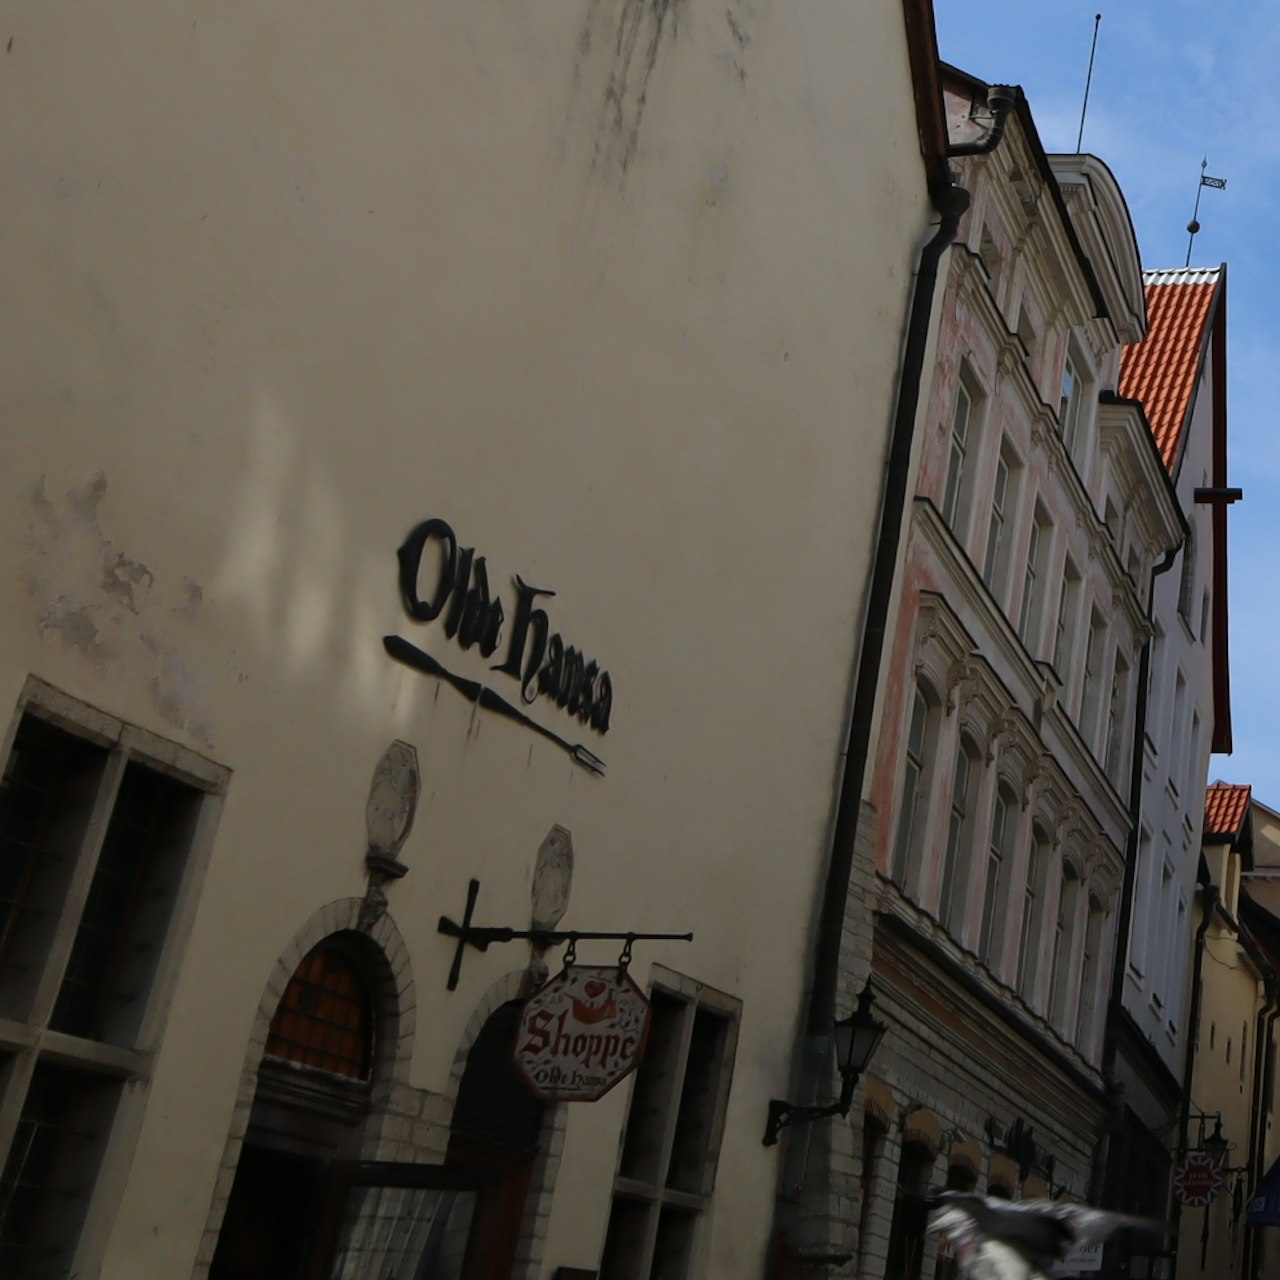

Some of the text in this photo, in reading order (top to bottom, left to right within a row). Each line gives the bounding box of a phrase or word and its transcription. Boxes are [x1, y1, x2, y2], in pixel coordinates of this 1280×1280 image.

[397, 519, 504, 658] Olde
[519, 1008, 637, 1070] Shoppe
[534, 1066, 567, 1084] Olde
